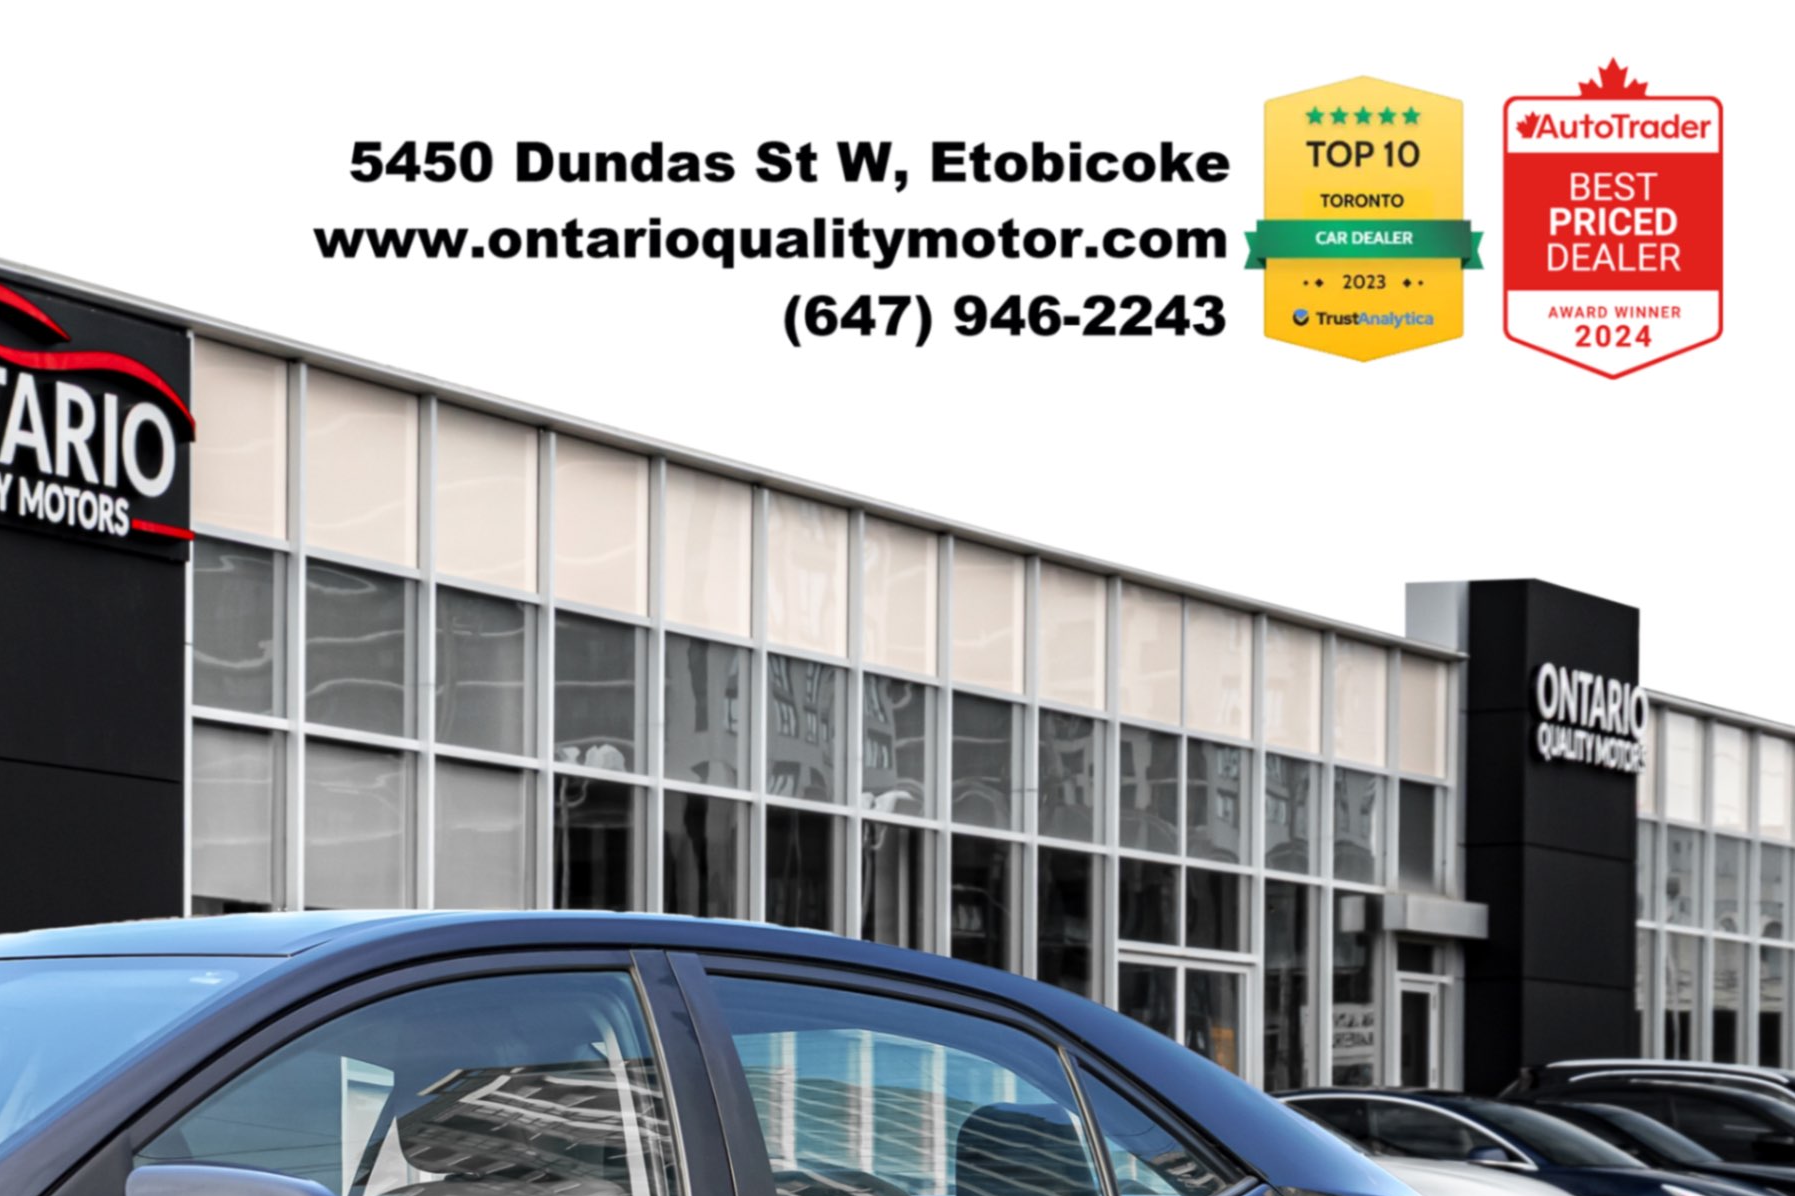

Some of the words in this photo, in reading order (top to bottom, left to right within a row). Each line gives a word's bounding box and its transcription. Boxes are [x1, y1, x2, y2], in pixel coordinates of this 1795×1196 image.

[18, 475, 131, 537] MOTORS
[1537, 662, 1649, 739] ONTARIO
[1536, 721, 1595, 764] QUALITY
